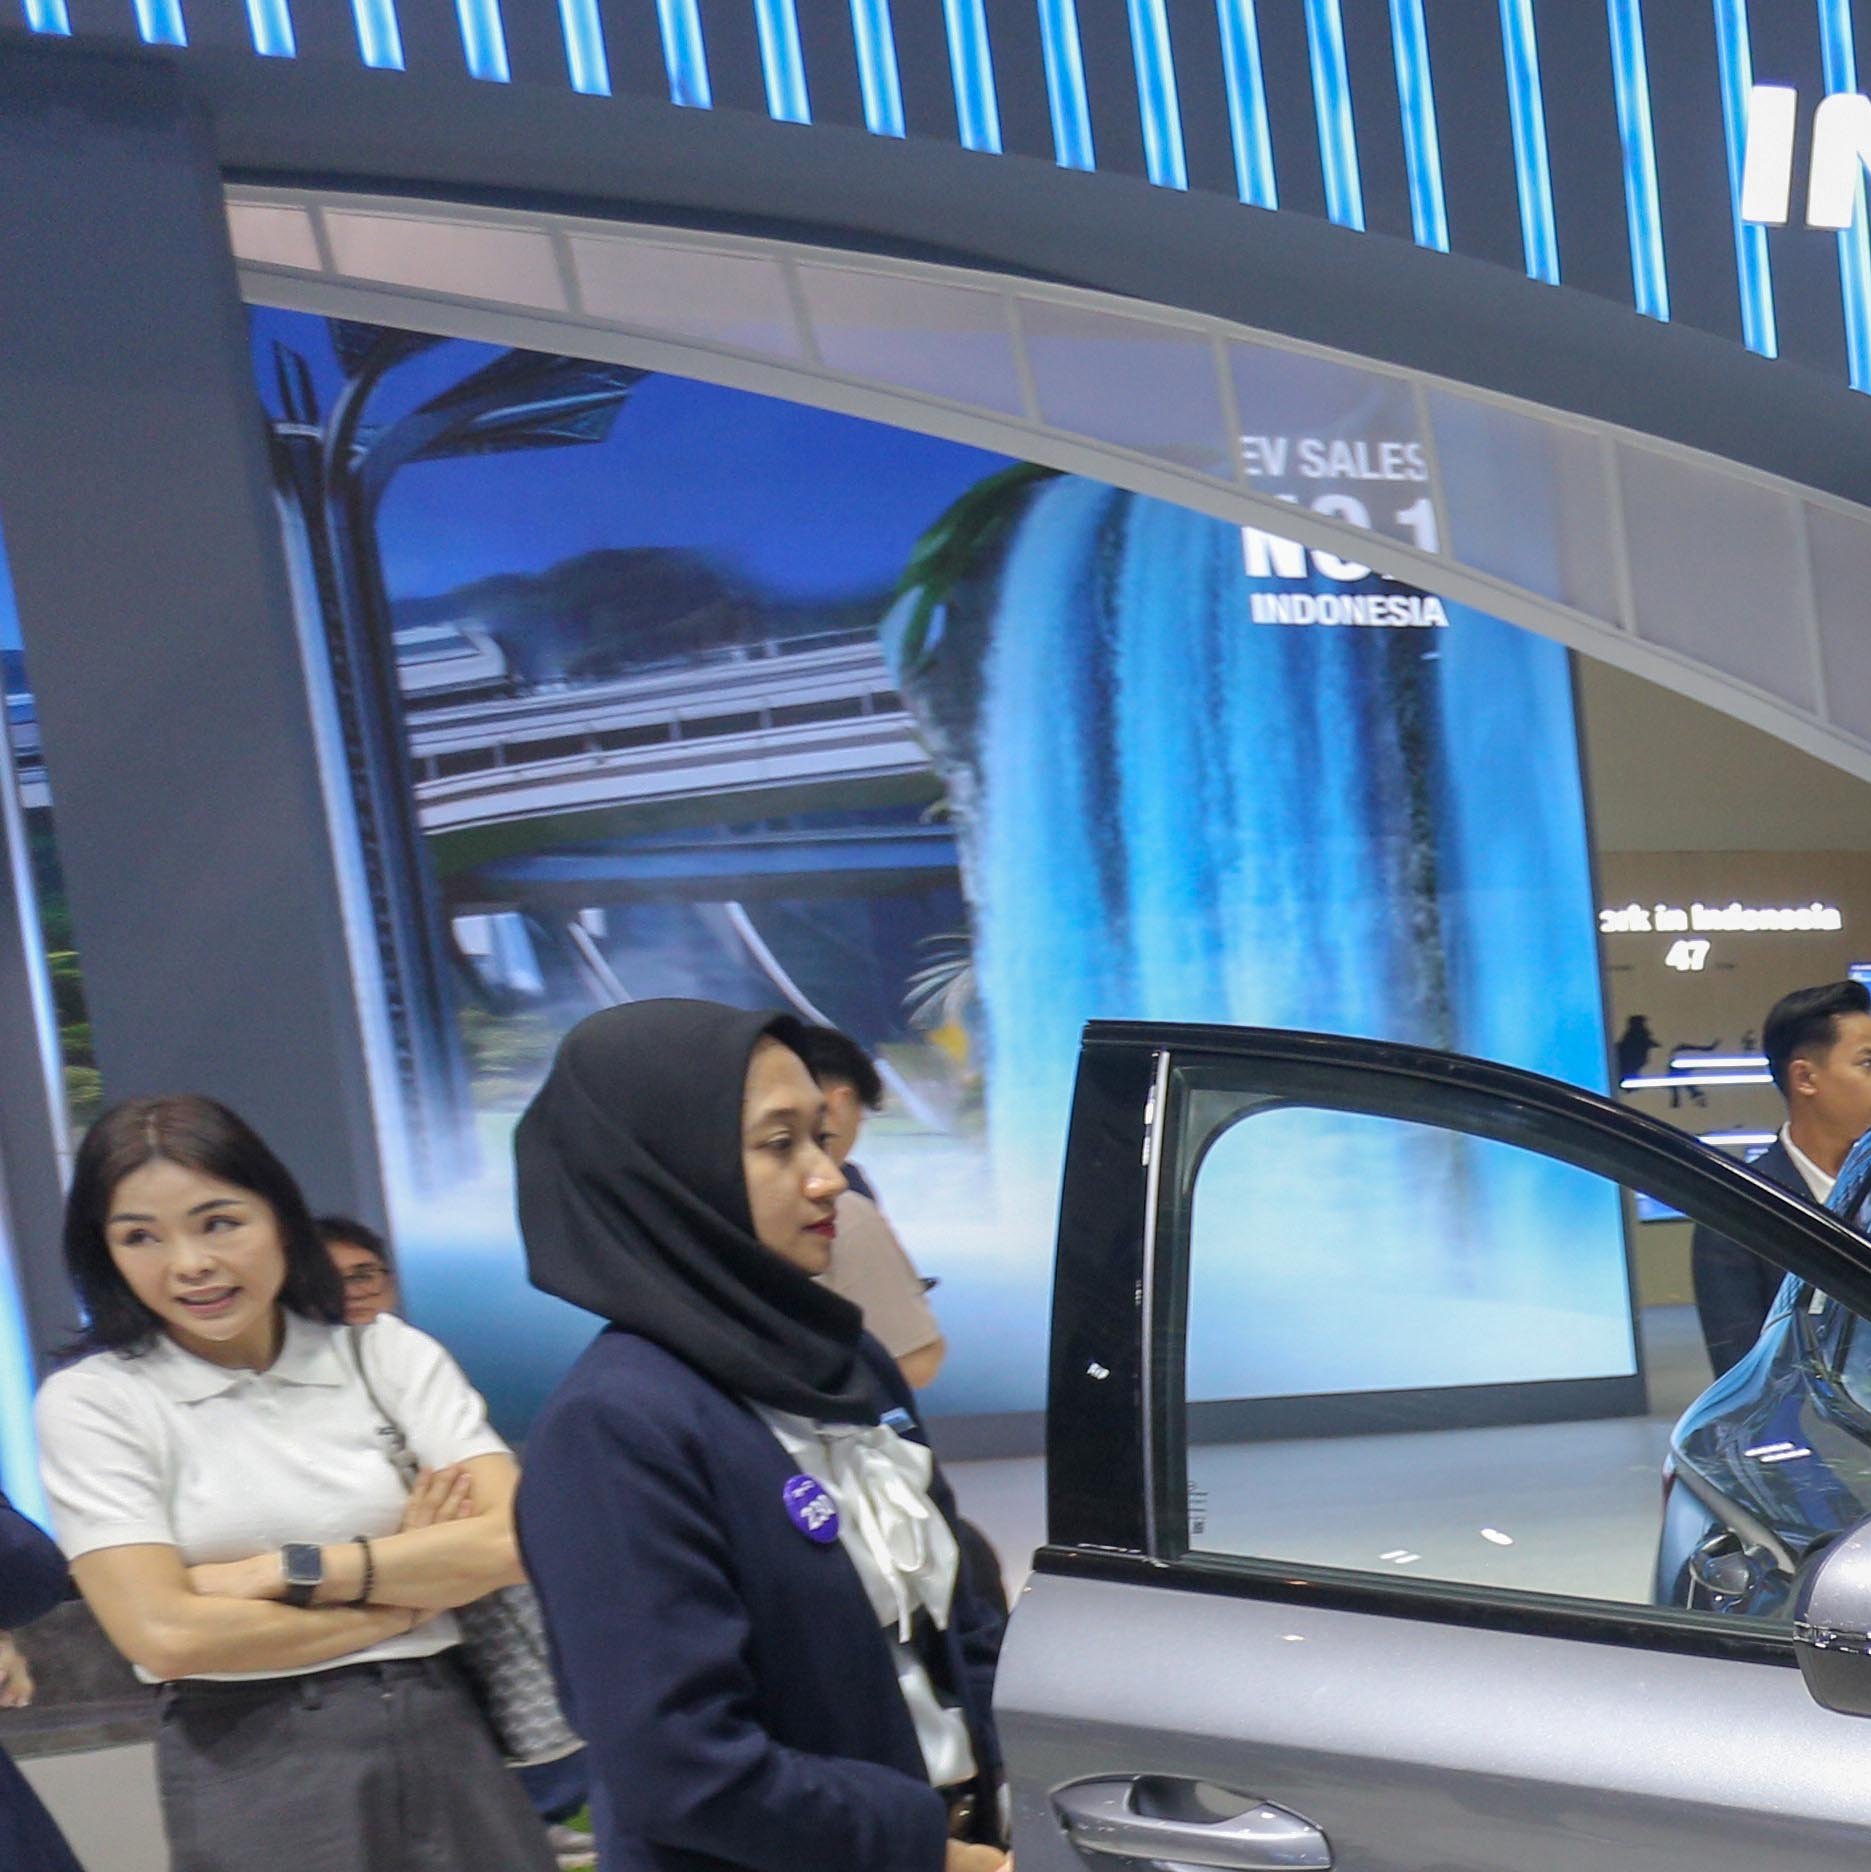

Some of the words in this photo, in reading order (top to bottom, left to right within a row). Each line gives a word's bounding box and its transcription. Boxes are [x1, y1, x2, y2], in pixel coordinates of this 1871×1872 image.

[1240, 436, 1288, 477] EV
[1298, 438, 1430, 481] SALES
[1250, 592, 1450, 628] INDONESIA
[1664, 939, 1711, 971] 47
